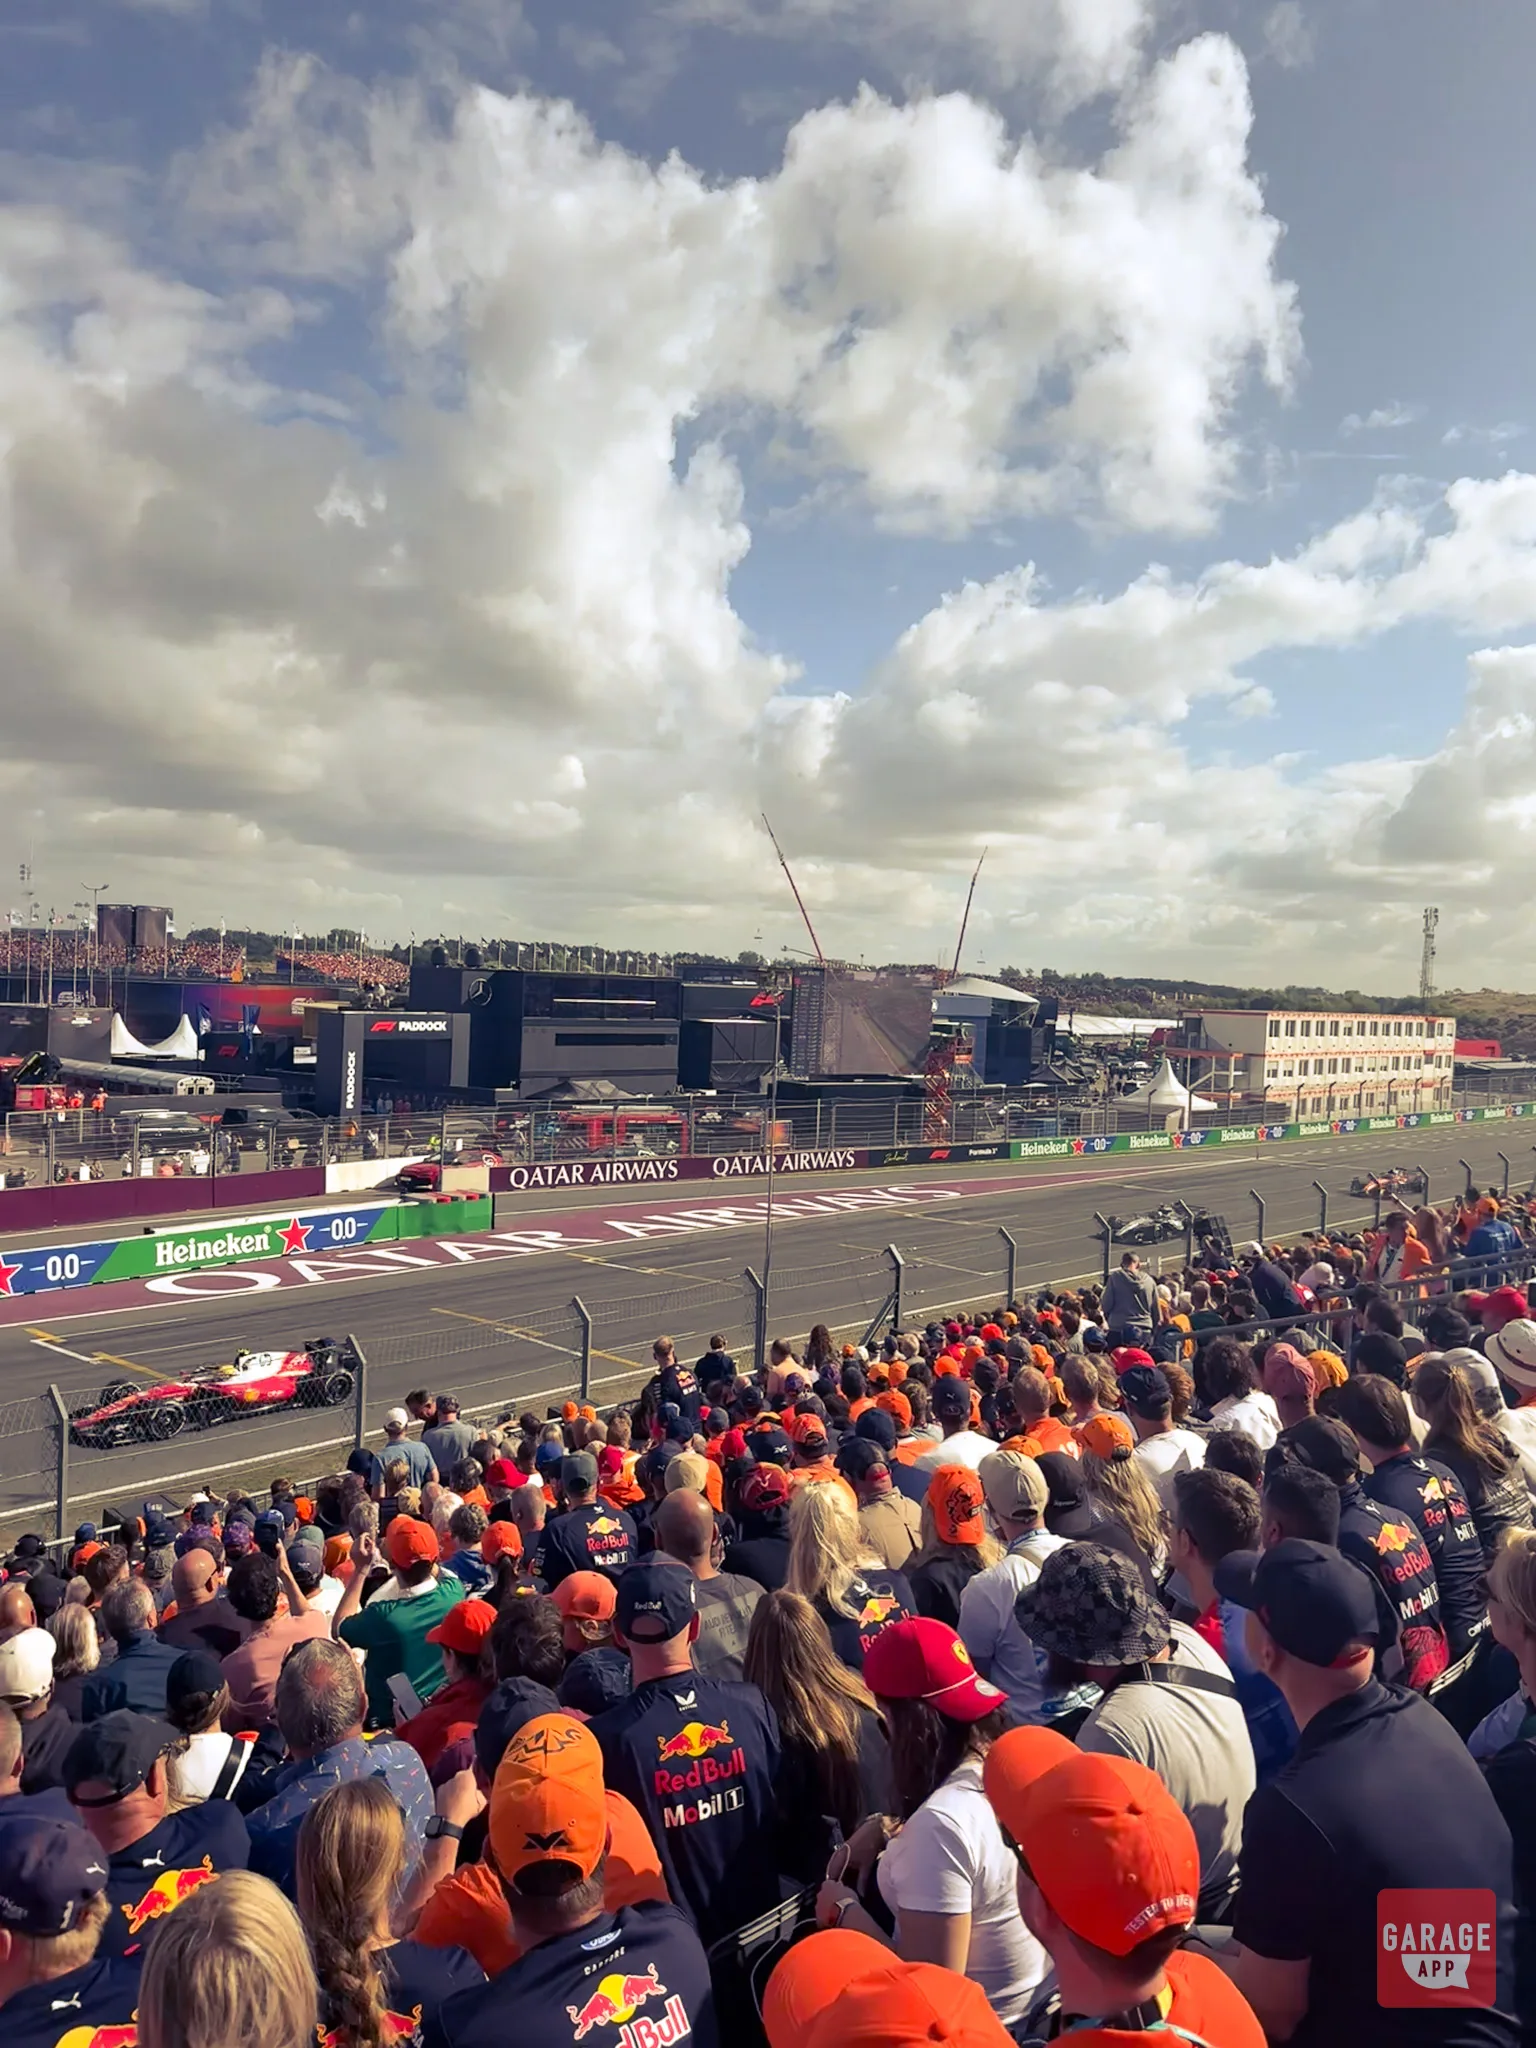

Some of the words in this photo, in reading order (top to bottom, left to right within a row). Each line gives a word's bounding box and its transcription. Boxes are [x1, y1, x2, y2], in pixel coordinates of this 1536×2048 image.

[399, 1021, 447, 1031] PADDOCK
[346, 1051, 356, 1110] PADDOCK
[1020, 1141, 1067, 1156] Heineken
[1130, 1135, 1170, 1149] Heineken
[1221, 1128, 1256, 1142] Heineken
[509, 1163, 585, 1189] QATAR
[589, 1159, 679, 1182] AIRWAYS
[712, 1155, 777, 1177] QATAR
[781, 1150, 855, 1172] AIRWAYS
[604, 1186, 961, 1239] AIRWAYS
[331, 1217, 357, 1240] 0.0
[155, 1233, 270, 1267] Heineken
[46, 1253, 79, 1281] 0.0
[587, 1534, 608, 1551] Red
[609, 1533, 629, 1548] Bull
[594, 1553, 618, 1566] Mobil
[1399, 1588, 1431, 1620] Mobil
[654, 1760, 701, 1794] Red
[702, 1747, 746, 1783] Bull
[663, 1794, 723, 1828] Mobil
